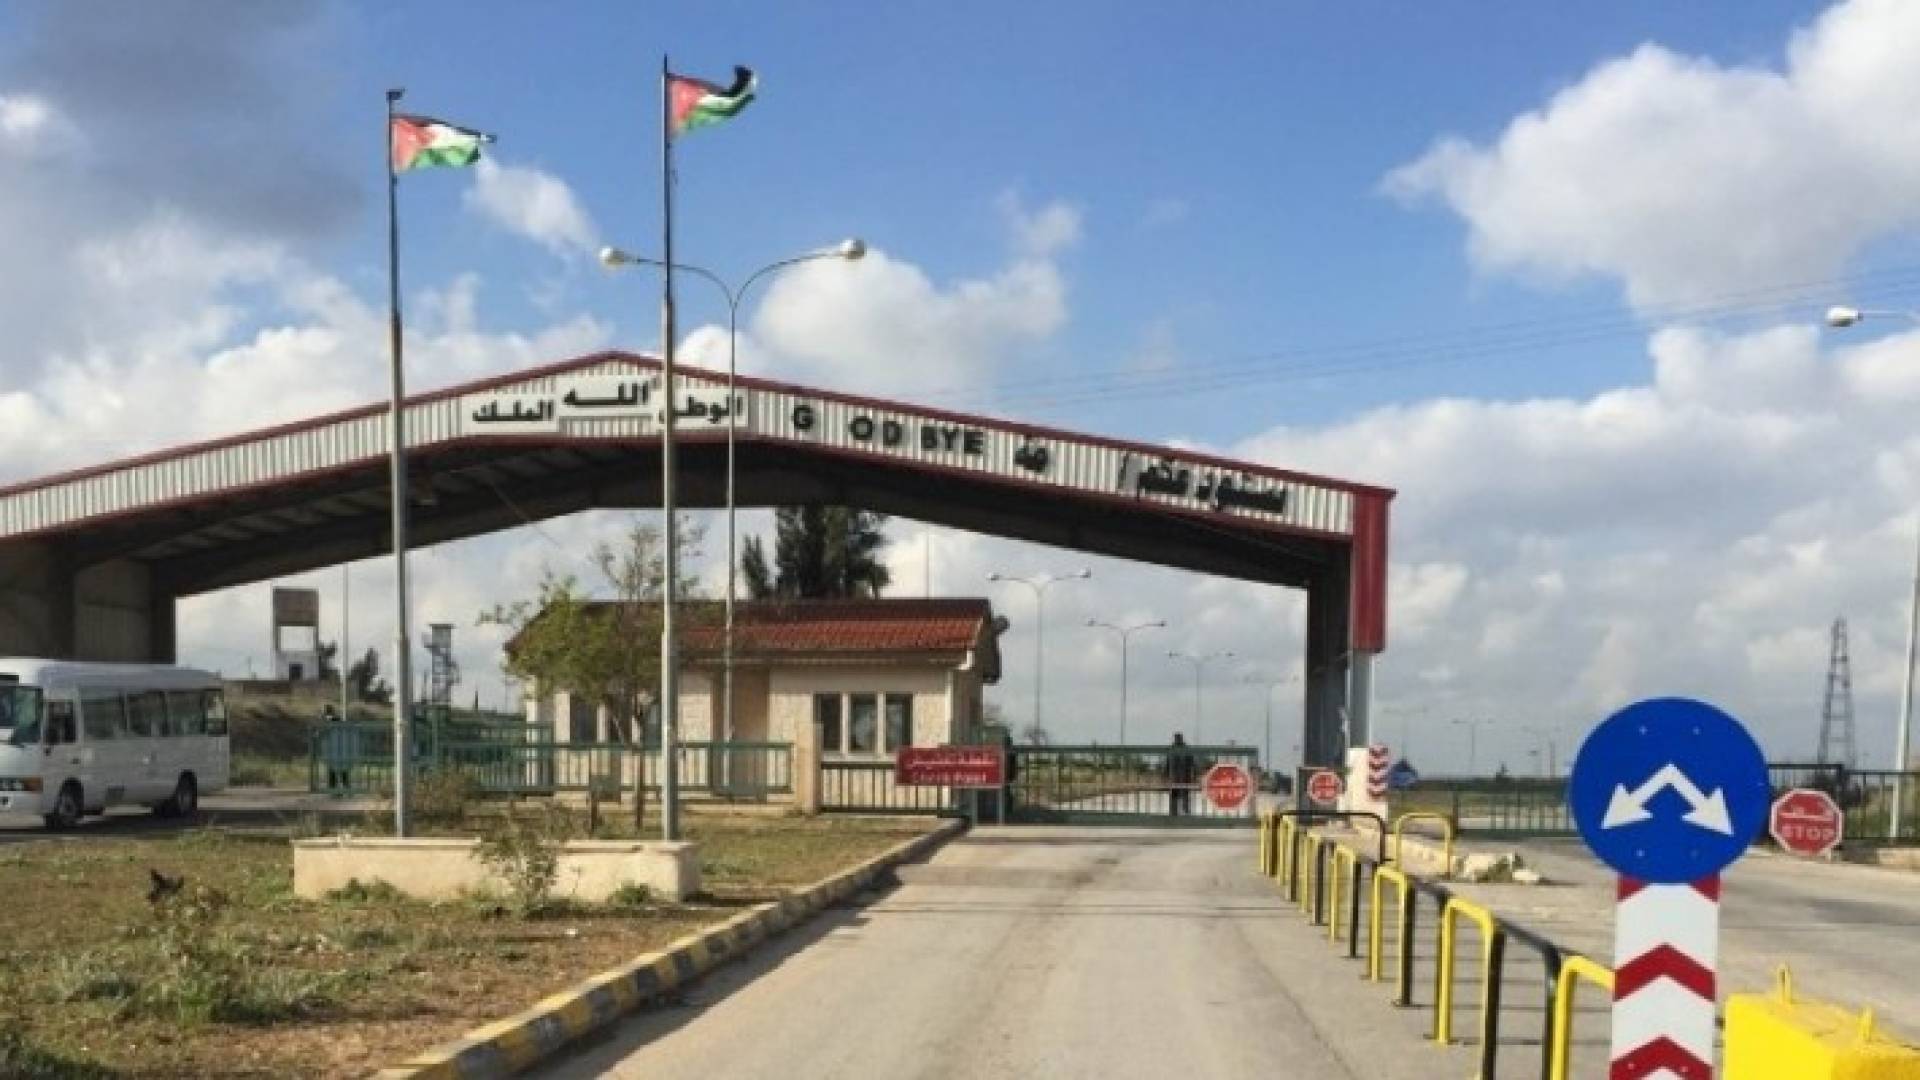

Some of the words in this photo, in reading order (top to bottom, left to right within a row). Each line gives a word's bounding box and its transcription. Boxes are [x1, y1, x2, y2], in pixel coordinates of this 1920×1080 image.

[563, 381, 651, 406] الله
[472, 399, 554, 422] الملك
[920, 424, 985, 455] BYE
[1781, 825, 1835, 841] STOP
